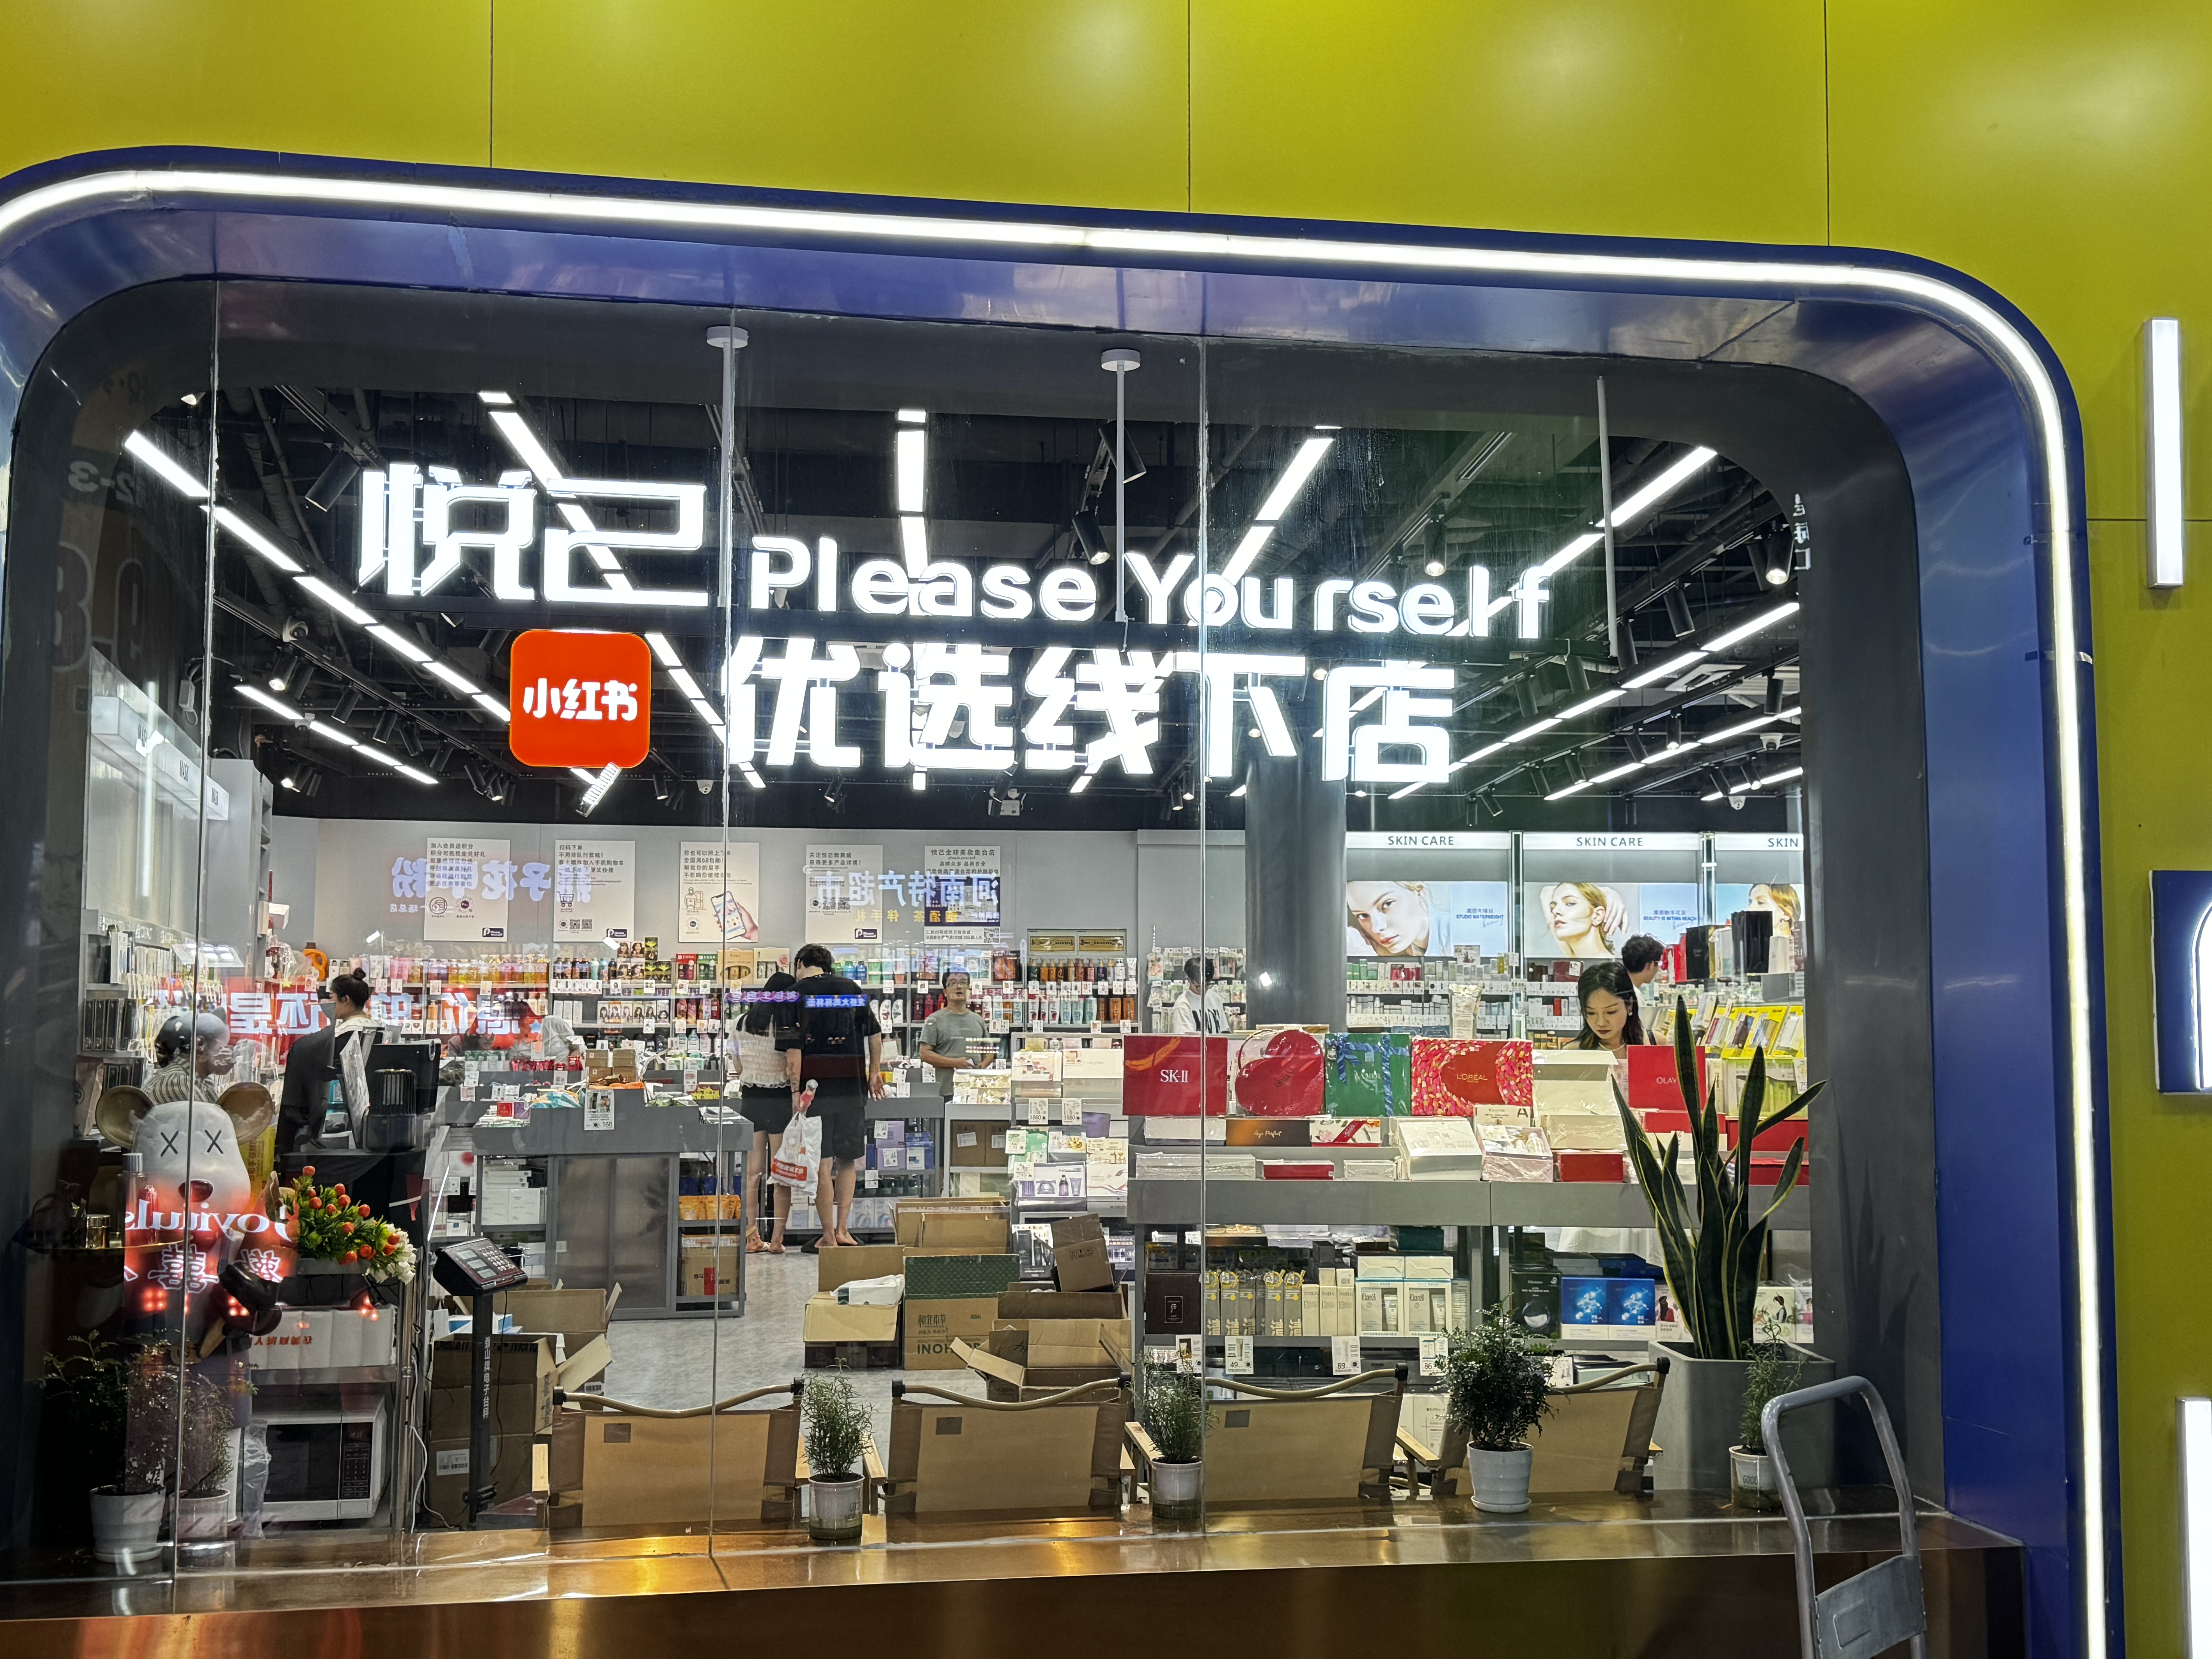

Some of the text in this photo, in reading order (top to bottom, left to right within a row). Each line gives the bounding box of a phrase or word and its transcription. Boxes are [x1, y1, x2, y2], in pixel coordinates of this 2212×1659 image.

[358, 463, 708, 607] 悦己
[751, 536, 1550, 639] Please Yourself
[522, 677, 638, 721] 小红书
[721, 636, 1455, 783] 优选线下店
[1388, 835, 1455, 846] SKIN CARE
[1576, 836, 1644, 847] SKIN CARE
[1767, 838, 1799, 848] SKIN
[1160, 1069, 1189, 1083] SK-II
